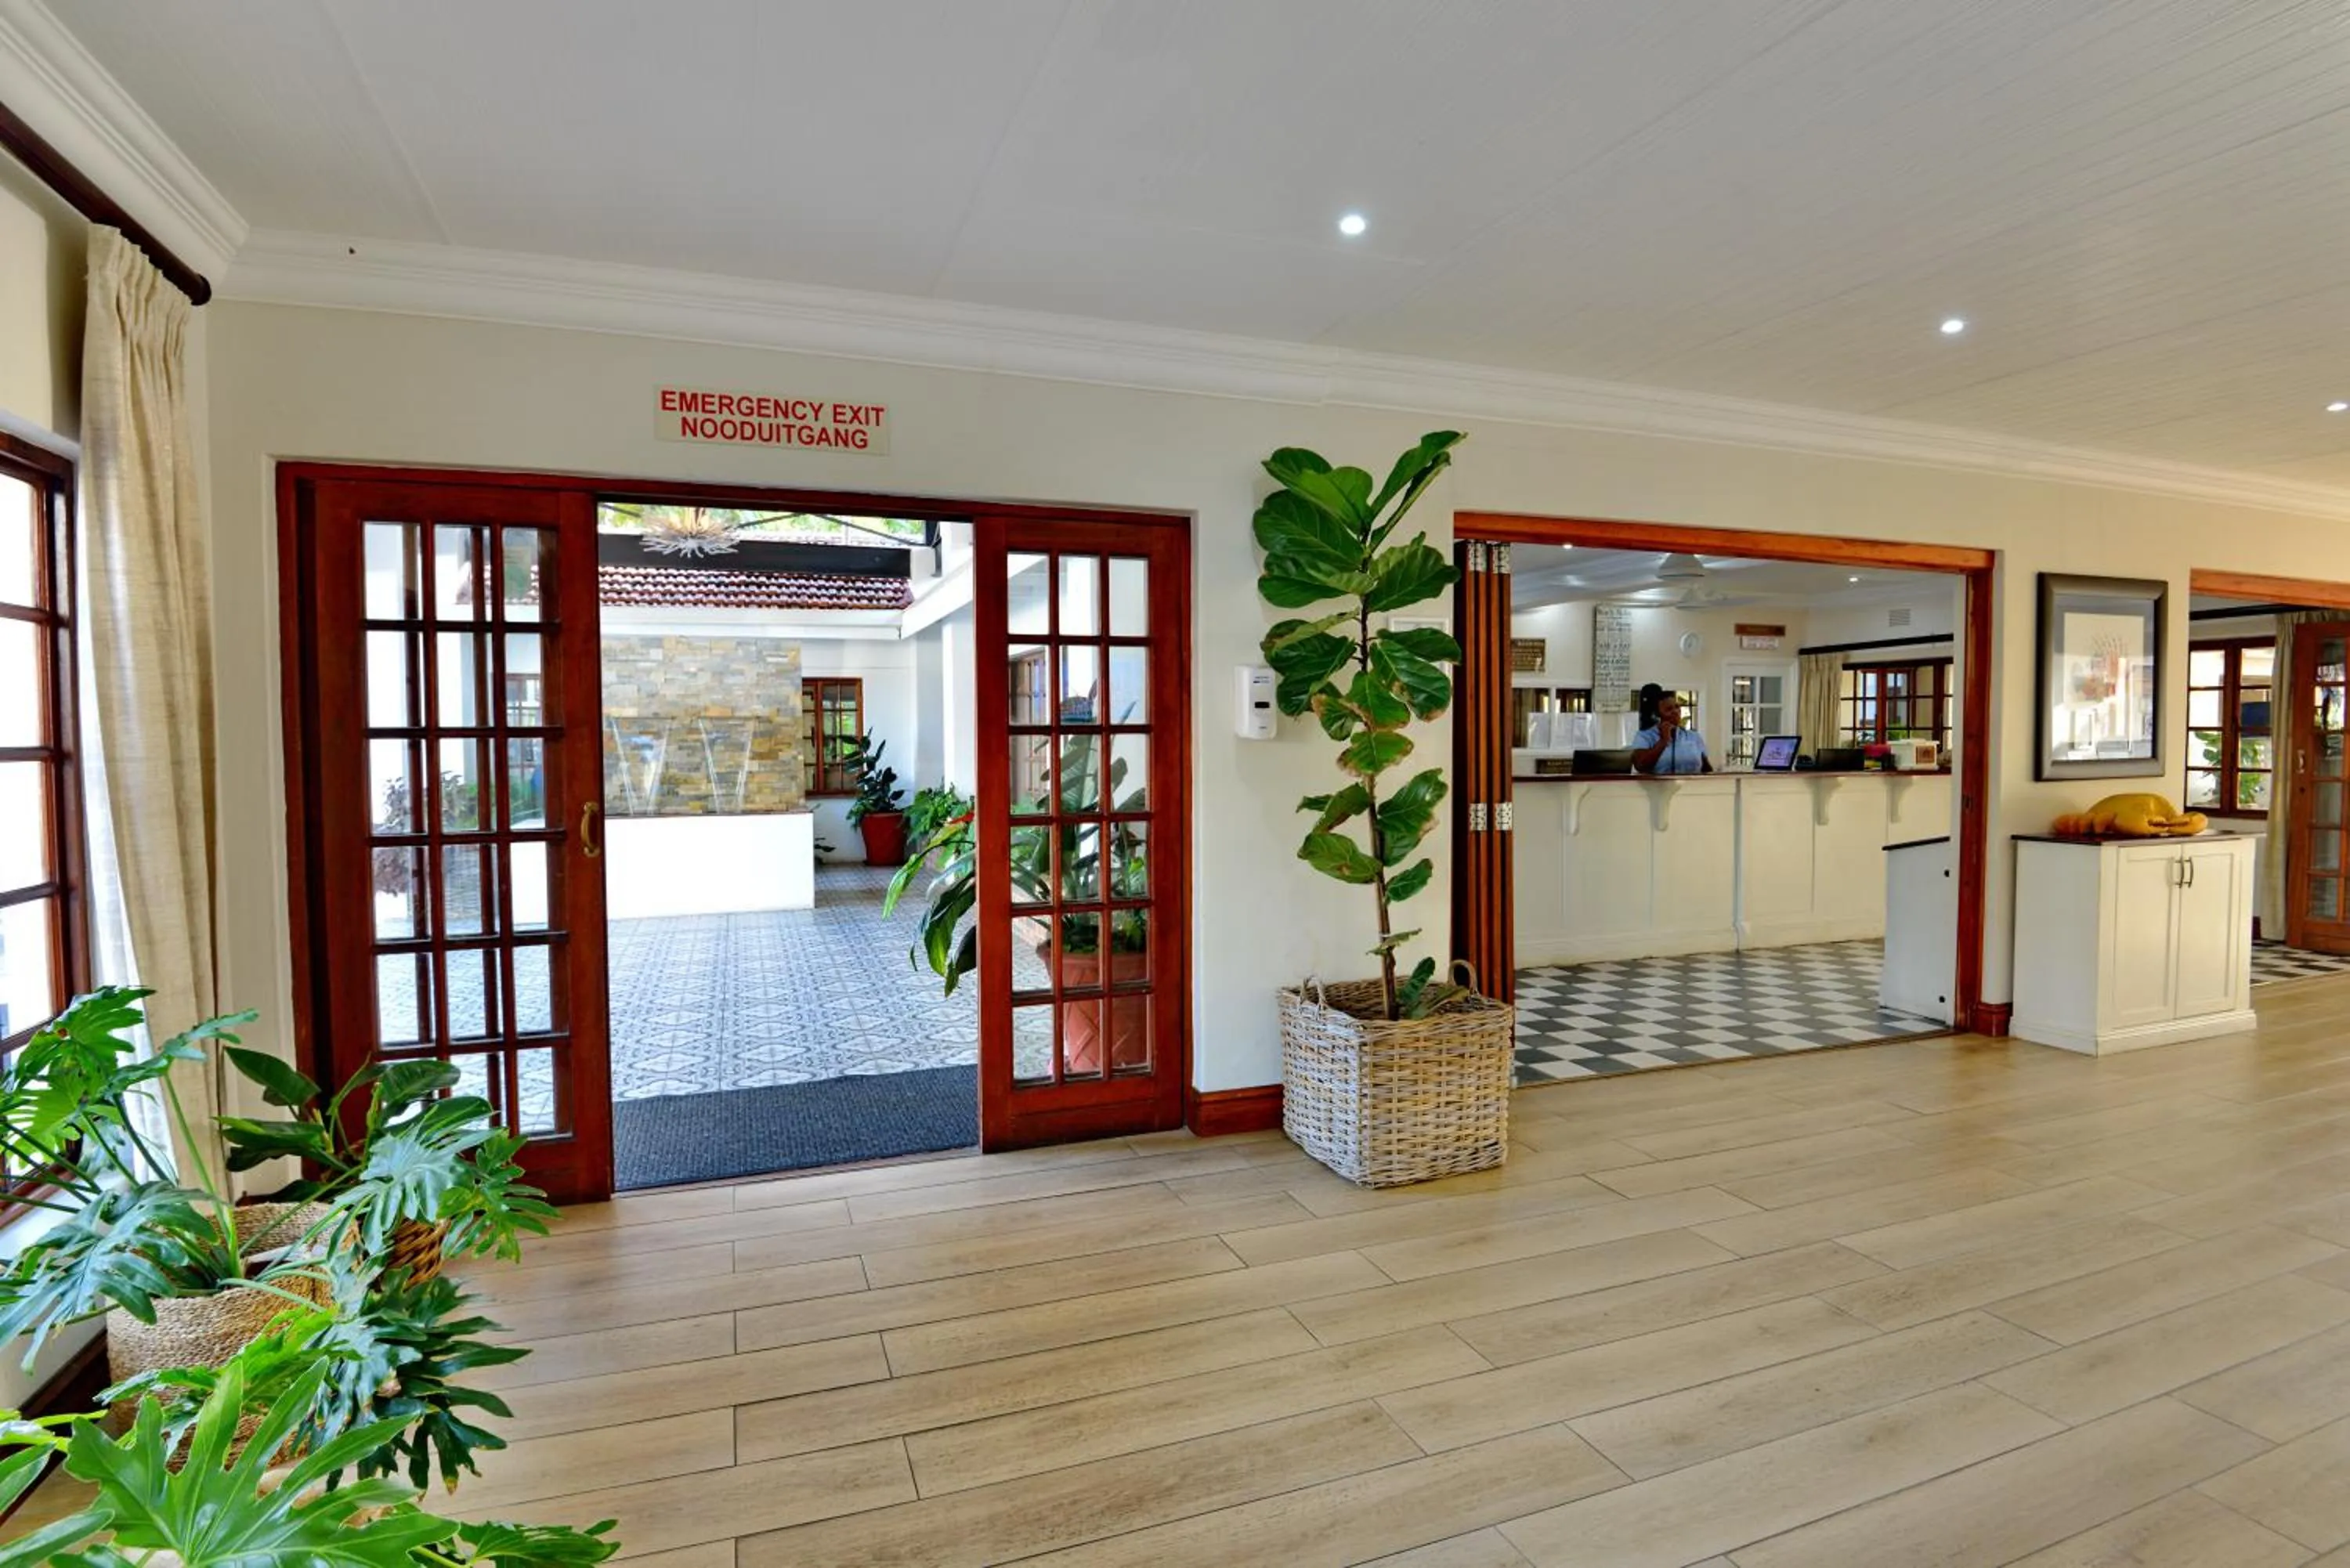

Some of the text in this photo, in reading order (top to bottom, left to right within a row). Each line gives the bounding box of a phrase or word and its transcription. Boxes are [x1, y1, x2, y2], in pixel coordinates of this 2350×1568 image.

[660, 390, 884, 426] EMERGENCY EXIT
[681, 417, 869, 449] NOODUITGANG
